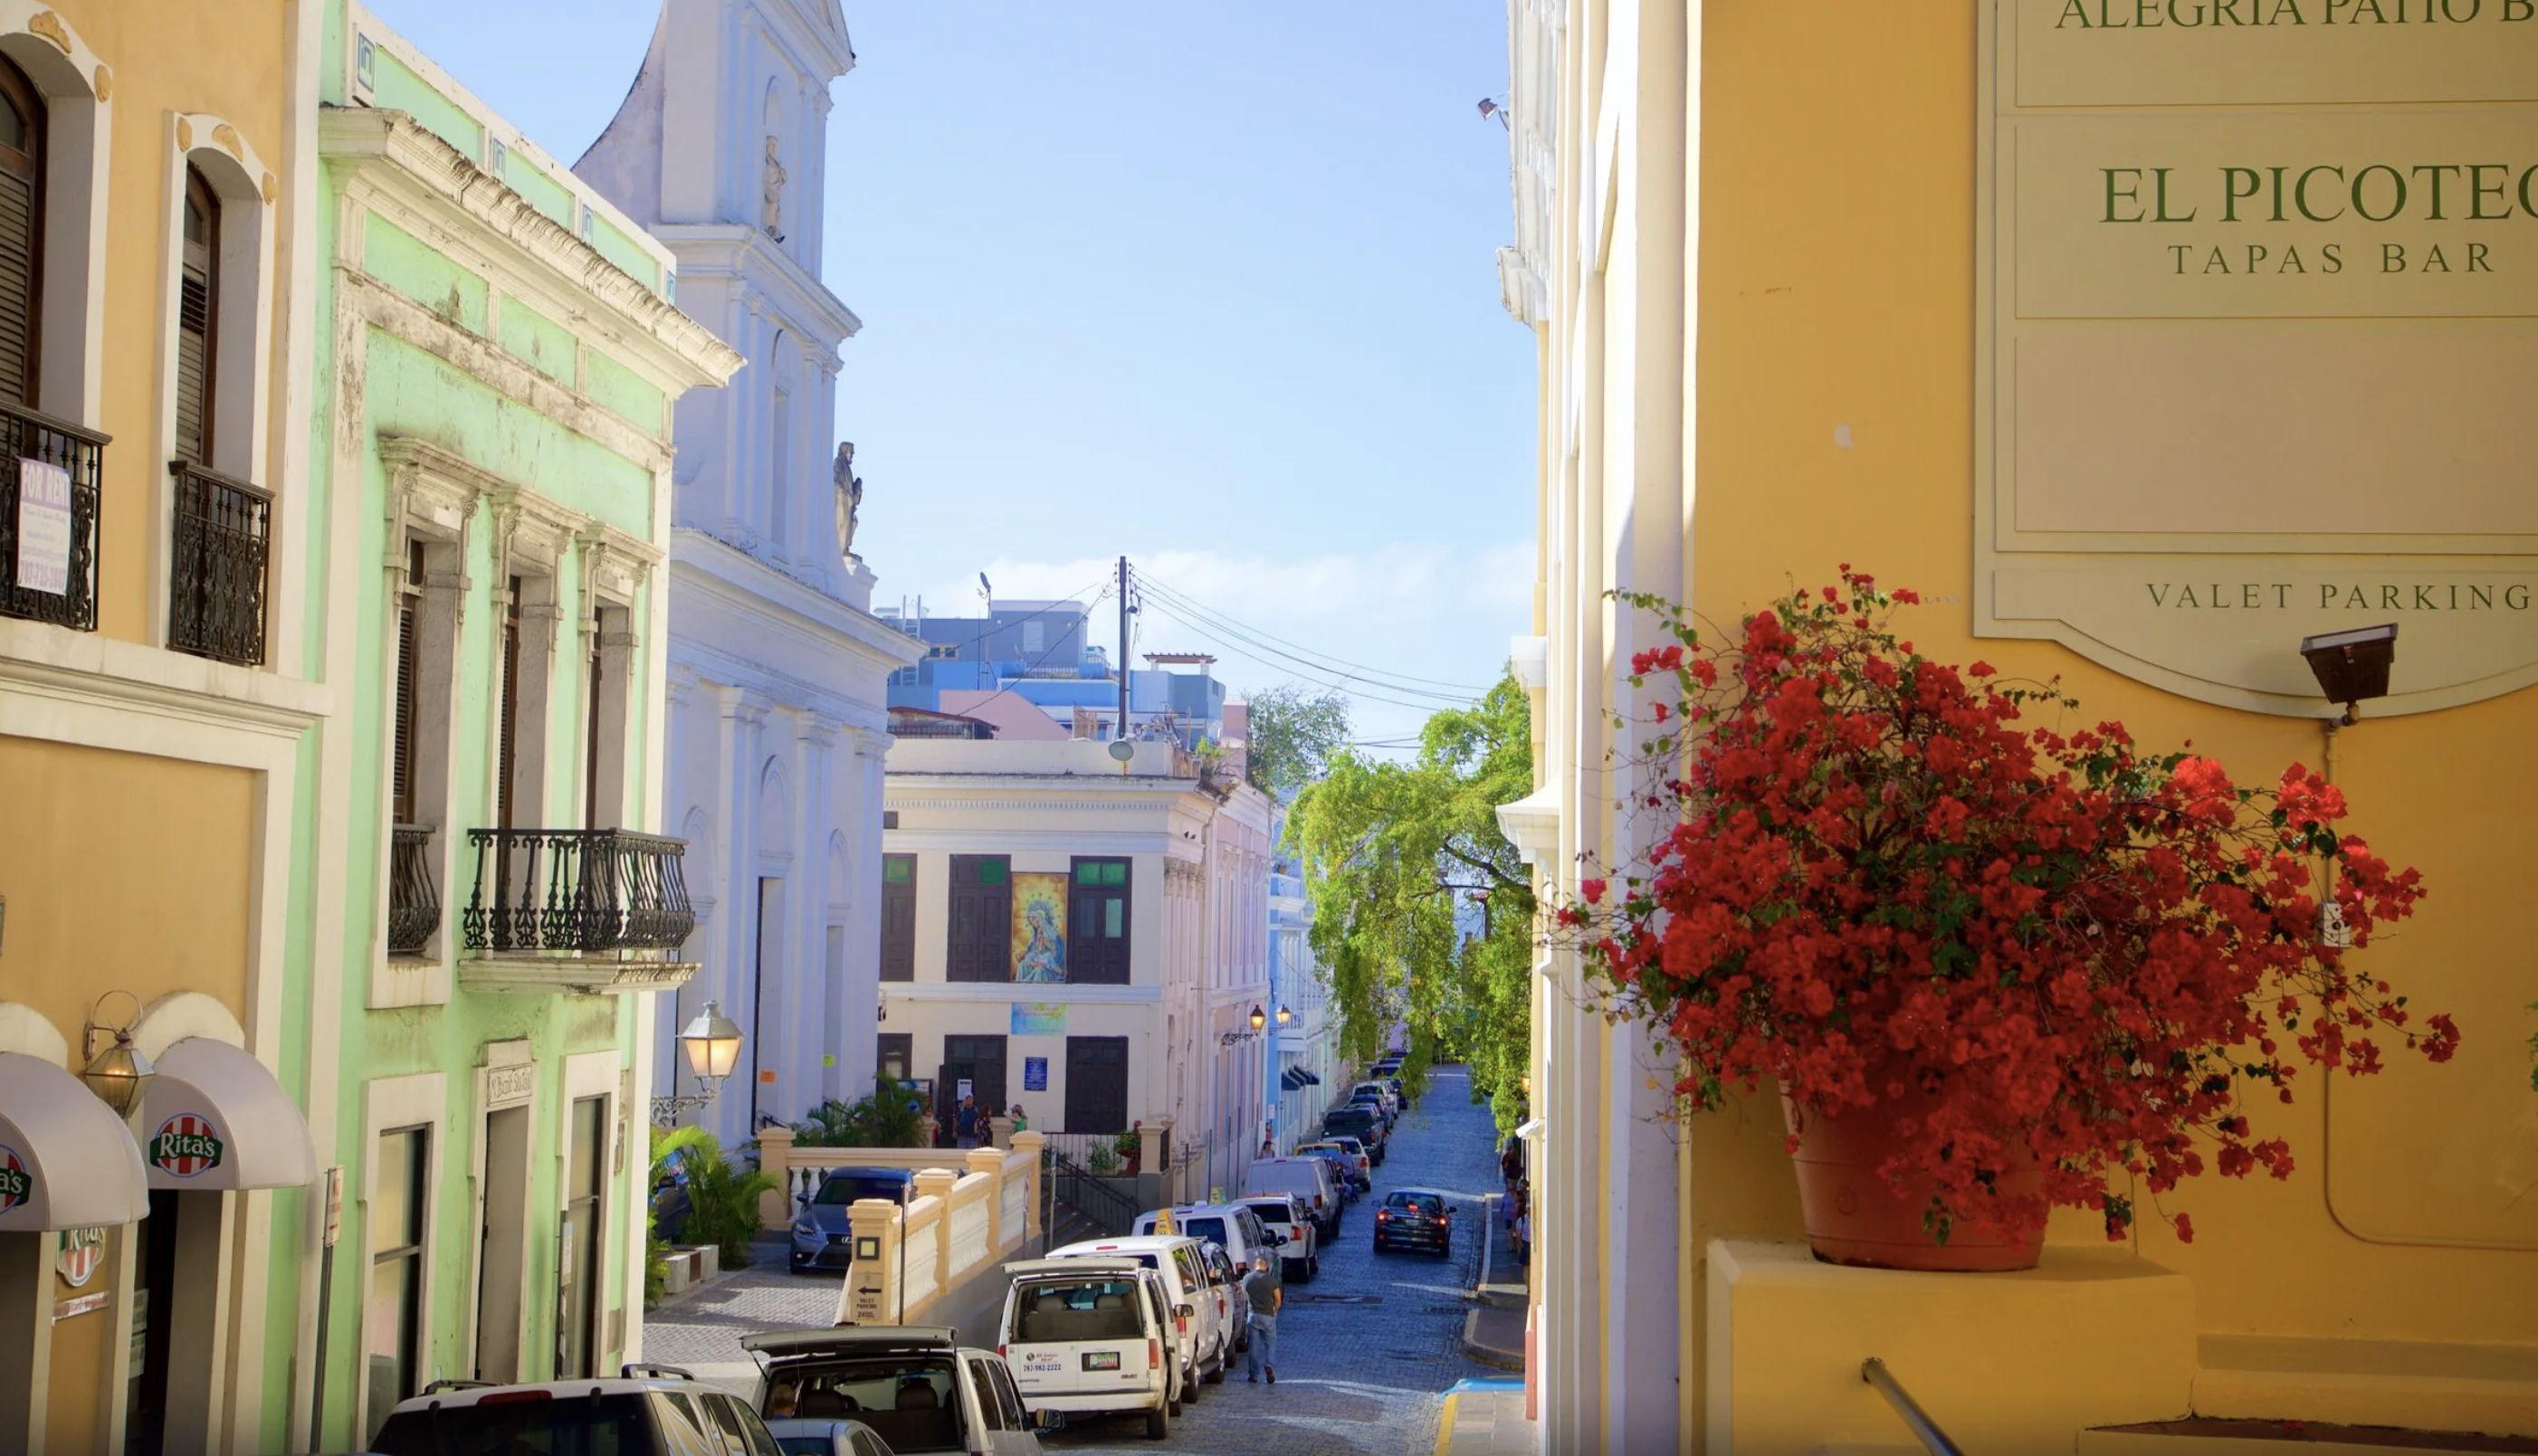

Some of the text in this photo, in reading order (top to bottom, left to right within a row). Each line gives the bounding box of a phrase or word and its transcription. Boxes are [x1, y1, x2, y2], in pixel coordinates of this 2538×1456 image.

[2054, 0, 2308, 29] ALEGRIA
[2099, 167, 2198, 224] EL
[2167, 243, 2495, 275] TAPAS BAR
[21, 462, 71, 506] FOR RENT
[2146, 583, 2532, 611] VALET PARKING
[159, 1132, 215, 1157] Rita's
